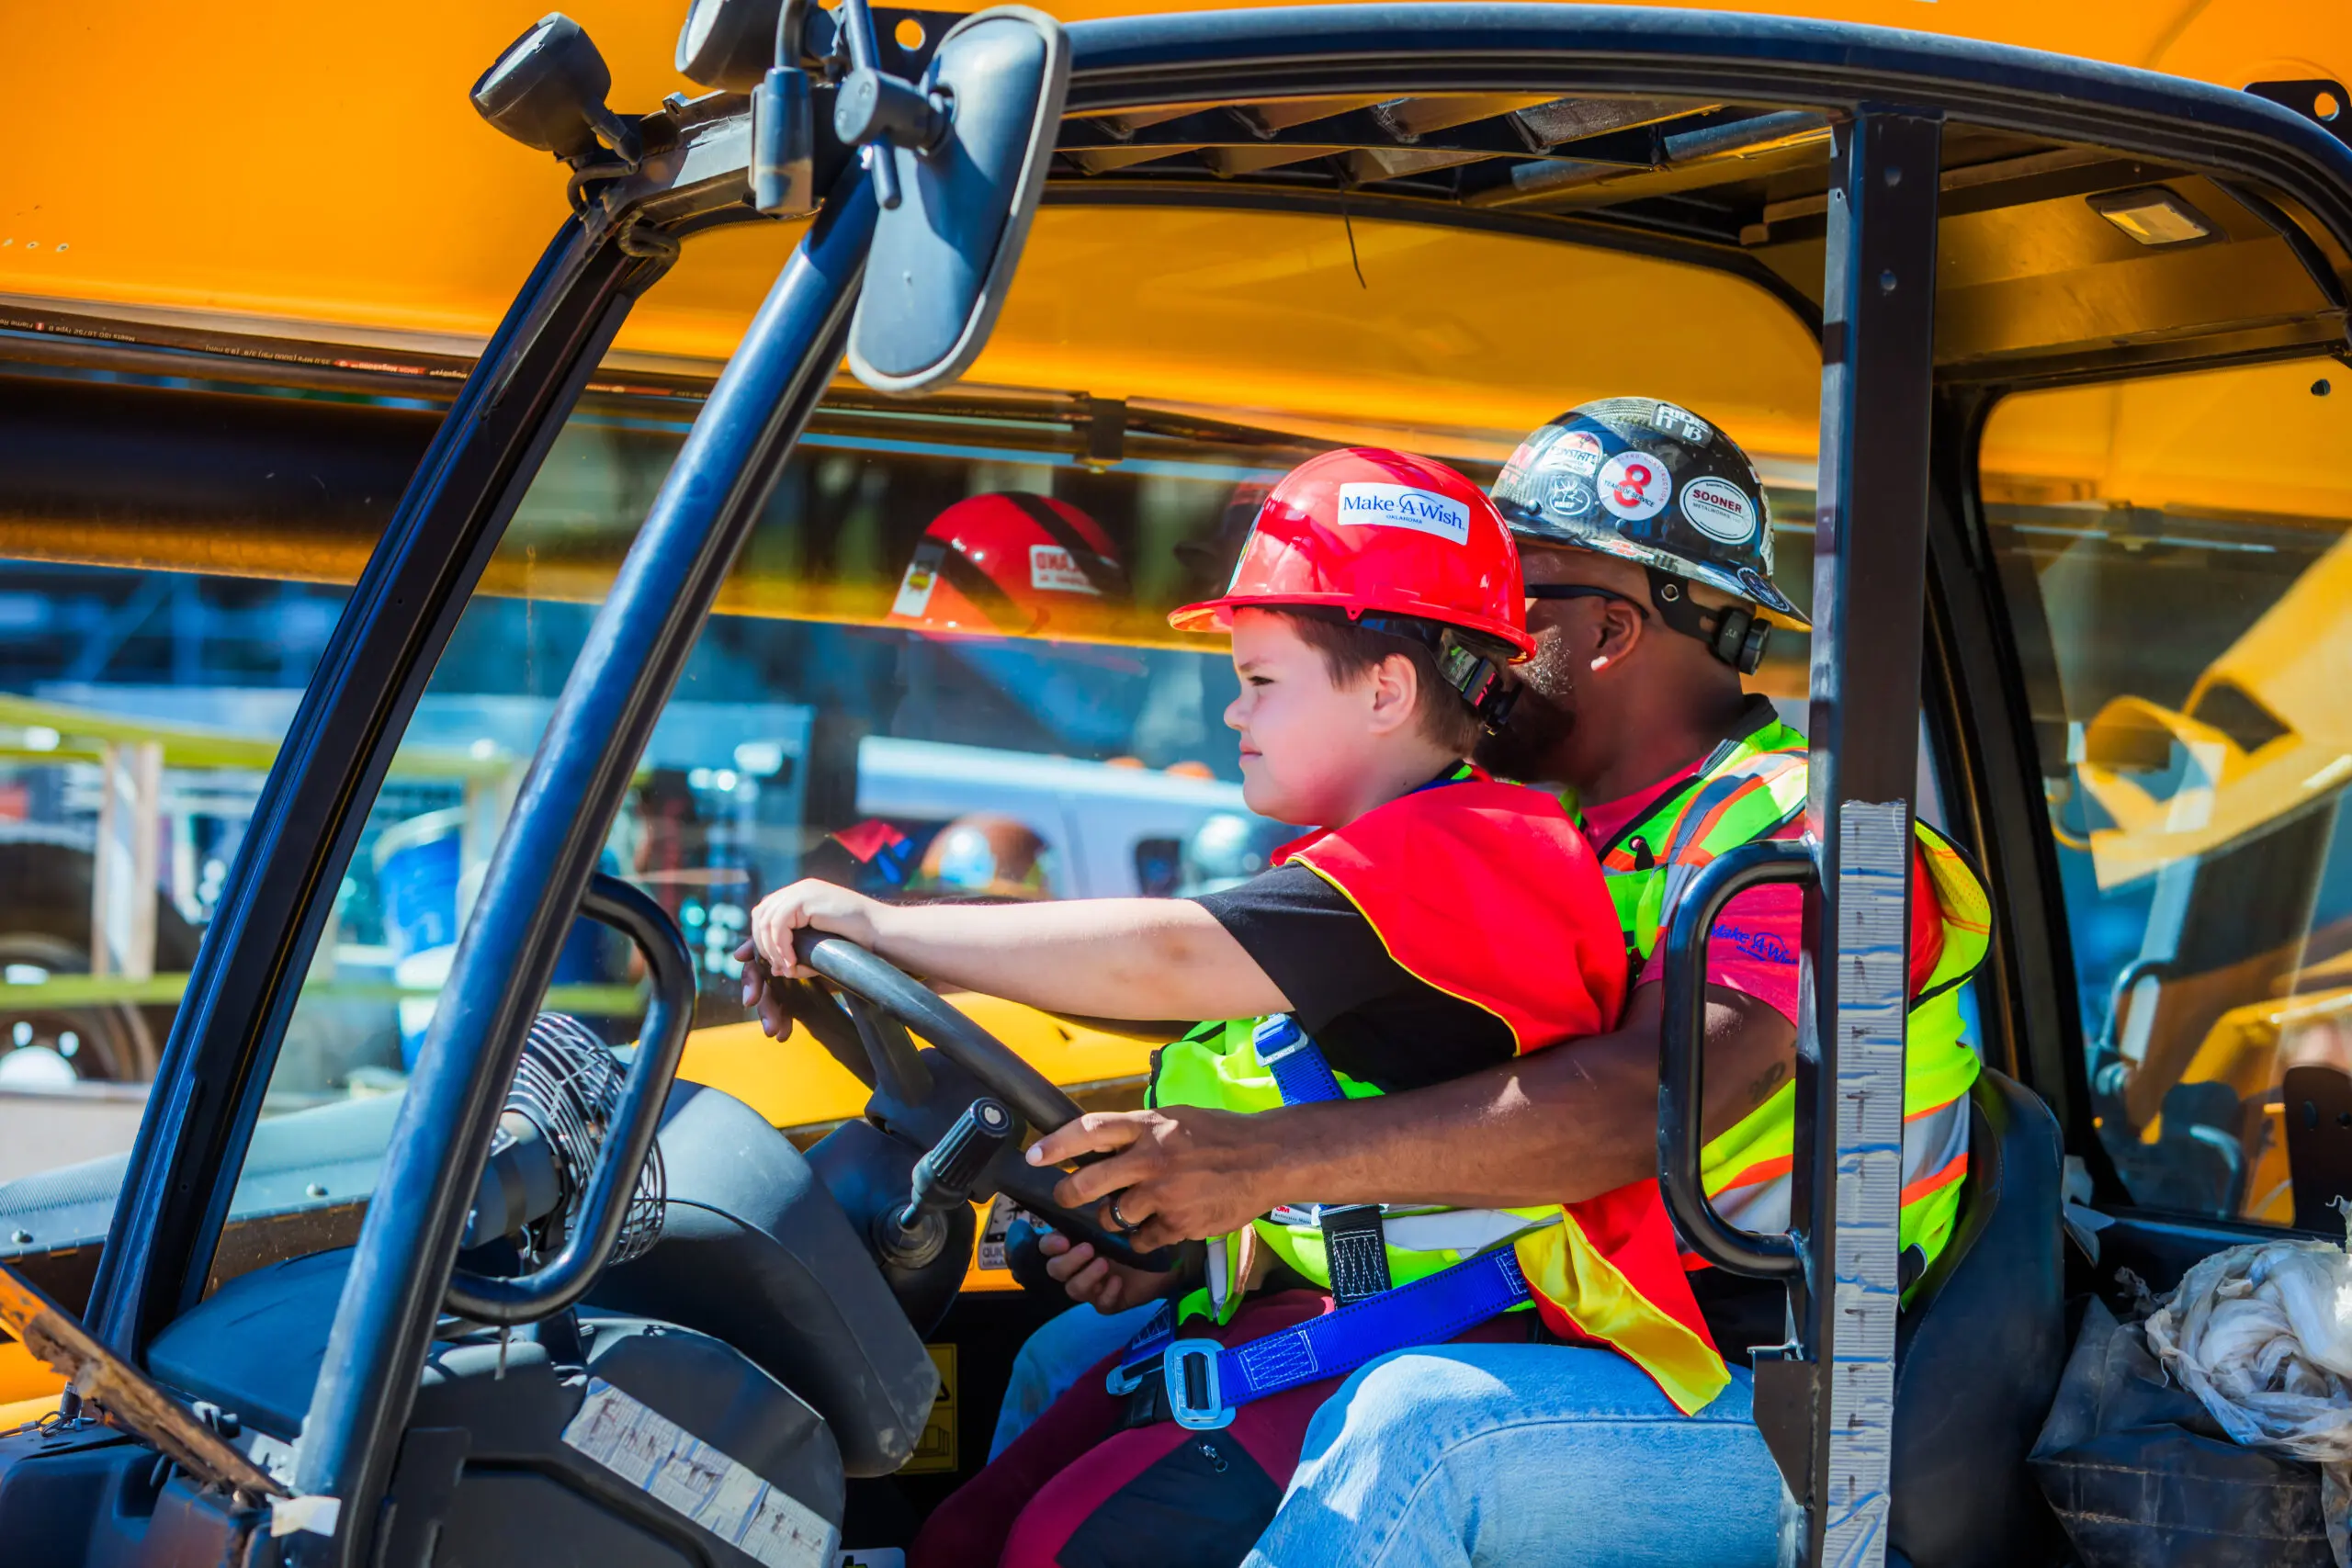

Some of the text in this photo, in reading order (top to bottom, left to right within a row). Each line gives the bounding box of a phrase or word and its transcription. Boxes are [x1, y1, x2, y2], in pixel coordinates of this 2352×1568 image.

[1632, 492, 1655, 507] SERVICE
[1692, 489, 1742, 513] SOONER
[1385, 513, 1423, 525] OKLAHOMA
